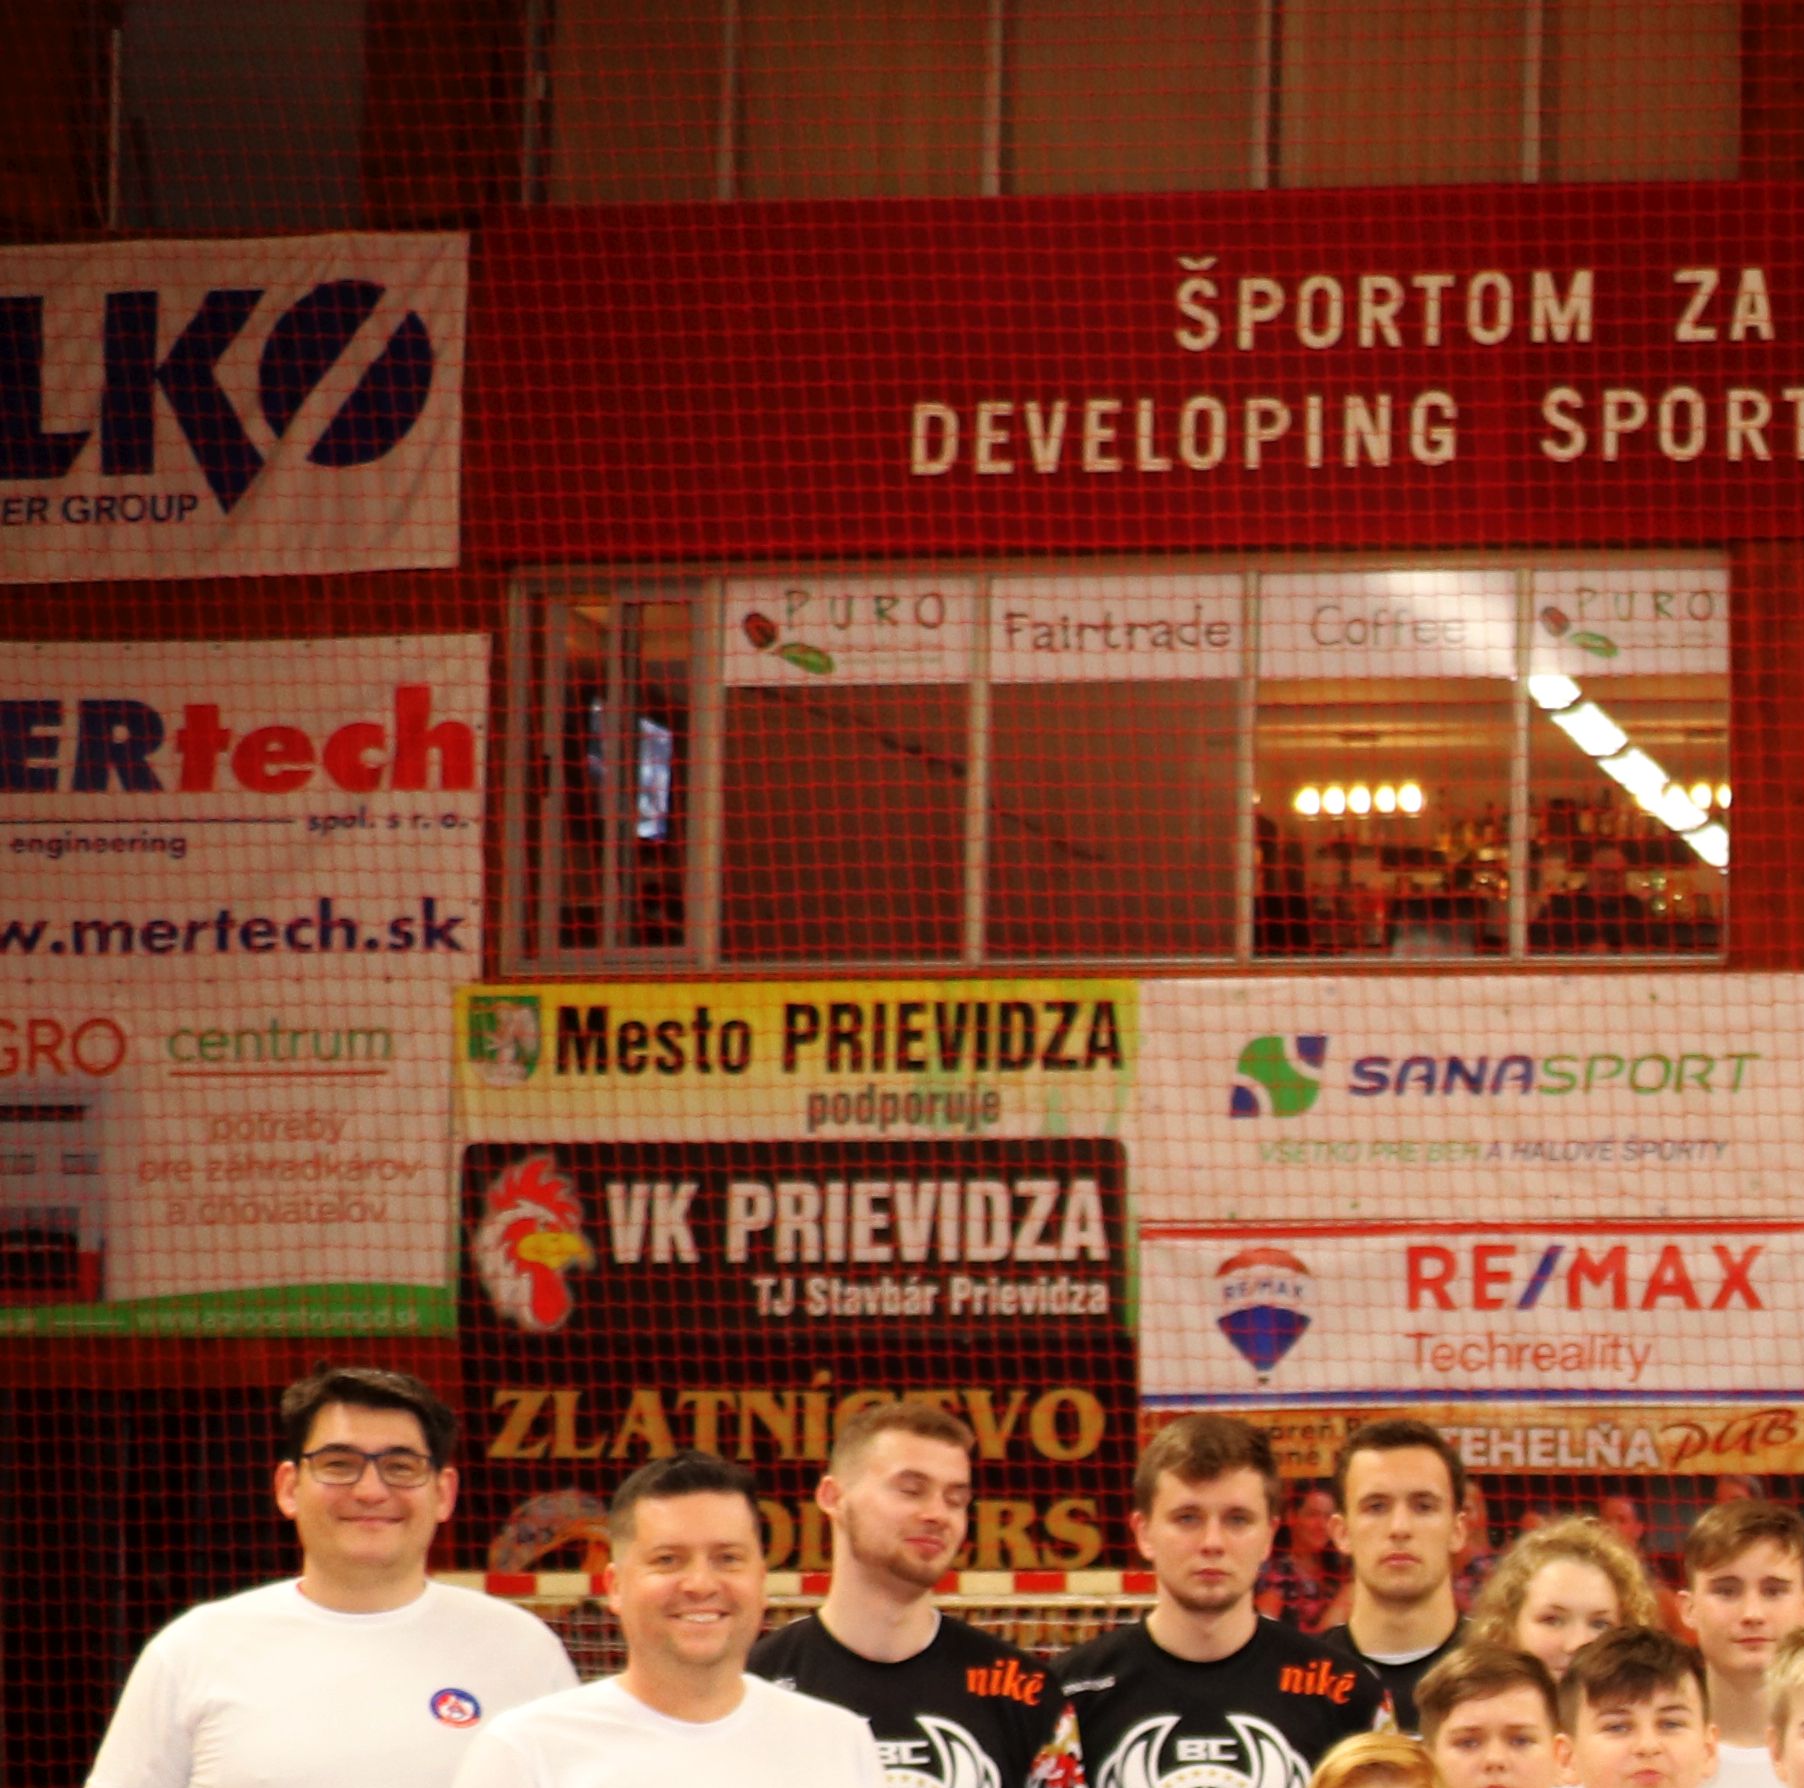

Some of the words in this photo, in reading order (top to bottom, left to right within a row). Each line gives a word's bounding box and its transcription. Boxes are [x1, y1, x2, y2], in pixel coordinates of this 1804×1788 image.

[1174, 256, 1595, 351] ŠPORTOM
[1673, 268, 1775, 343] ZA
[911, 391, 1458, 475] DEVELOPING
[62, 493, 199, 526] GROUP
[1005, 605, 1232, 652] Fairtrade
[1309, 605, 1468, 648] Coffee
[9, 830, 188, 858] engineering
[307, 806, 375, 837] spol.
[168, 1017, 392, 1063] centrum
[555, 1004, 752, 1076] Mesto
[783, 1000, 1124, 1072] PRIEVIDZA
[1348, 1051, 1762, 1097] SANASPORT
[208, 1111, 349, 1145] potreby
[806, 1084, 1002, 1132] podporuje
[607, 1181, 700, 1265] VK
[725, 1177, 1110, 1265] PRIEVIDZA
[752, 1278, 795, 1317] TJ
[805, 1273, 939, 1317] Stavbár
[949, 1275, 1109, 1317] Prievidza
[1404, 1243, 1765, 1312] RE/MAX
[1404, 1331, 1651, 1382] Techreality
[966, 1659, 1046, 1706] niké
[1280, 1660, 1356, 1705] niké
[1177, 1738, 1239, 1763] BC
